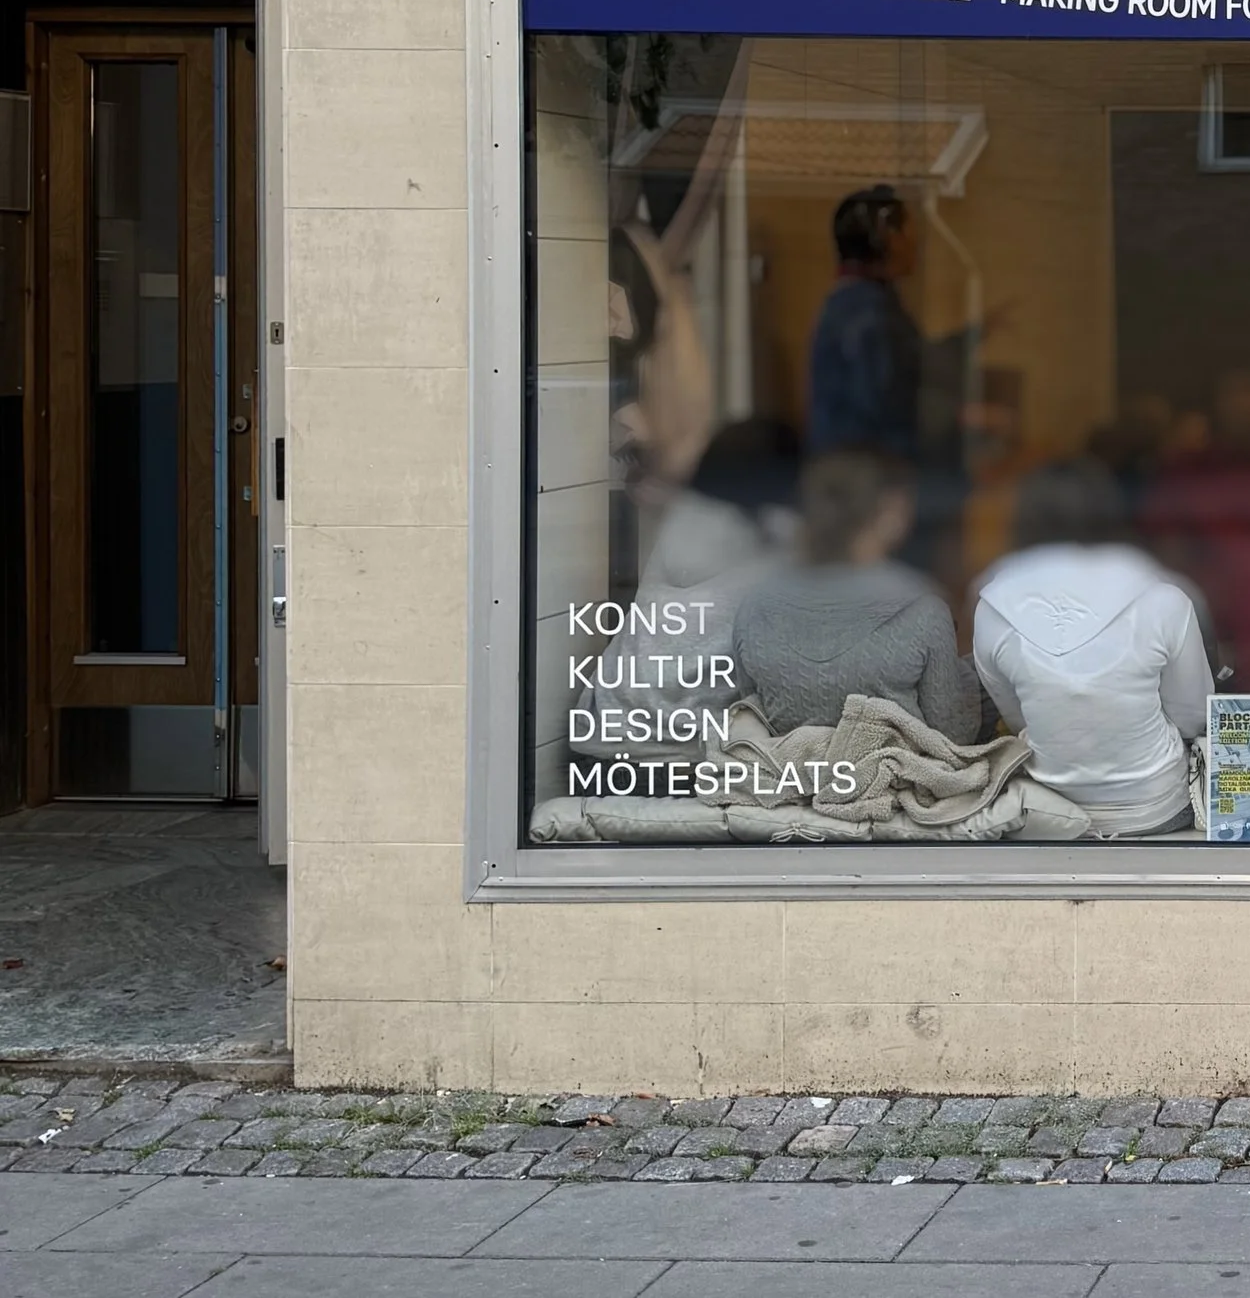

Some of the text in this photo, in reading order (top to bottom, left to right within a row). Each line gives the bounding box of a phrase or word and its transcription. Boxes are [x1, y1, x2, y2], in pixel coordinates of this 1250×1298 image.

[568, 602, 715, 636] KONST
[568, 655, 737, 689] KULTUR
[568, 708, 730, 743] DESIGN
[568, 753, 857, 796] MÖTESPLATS
